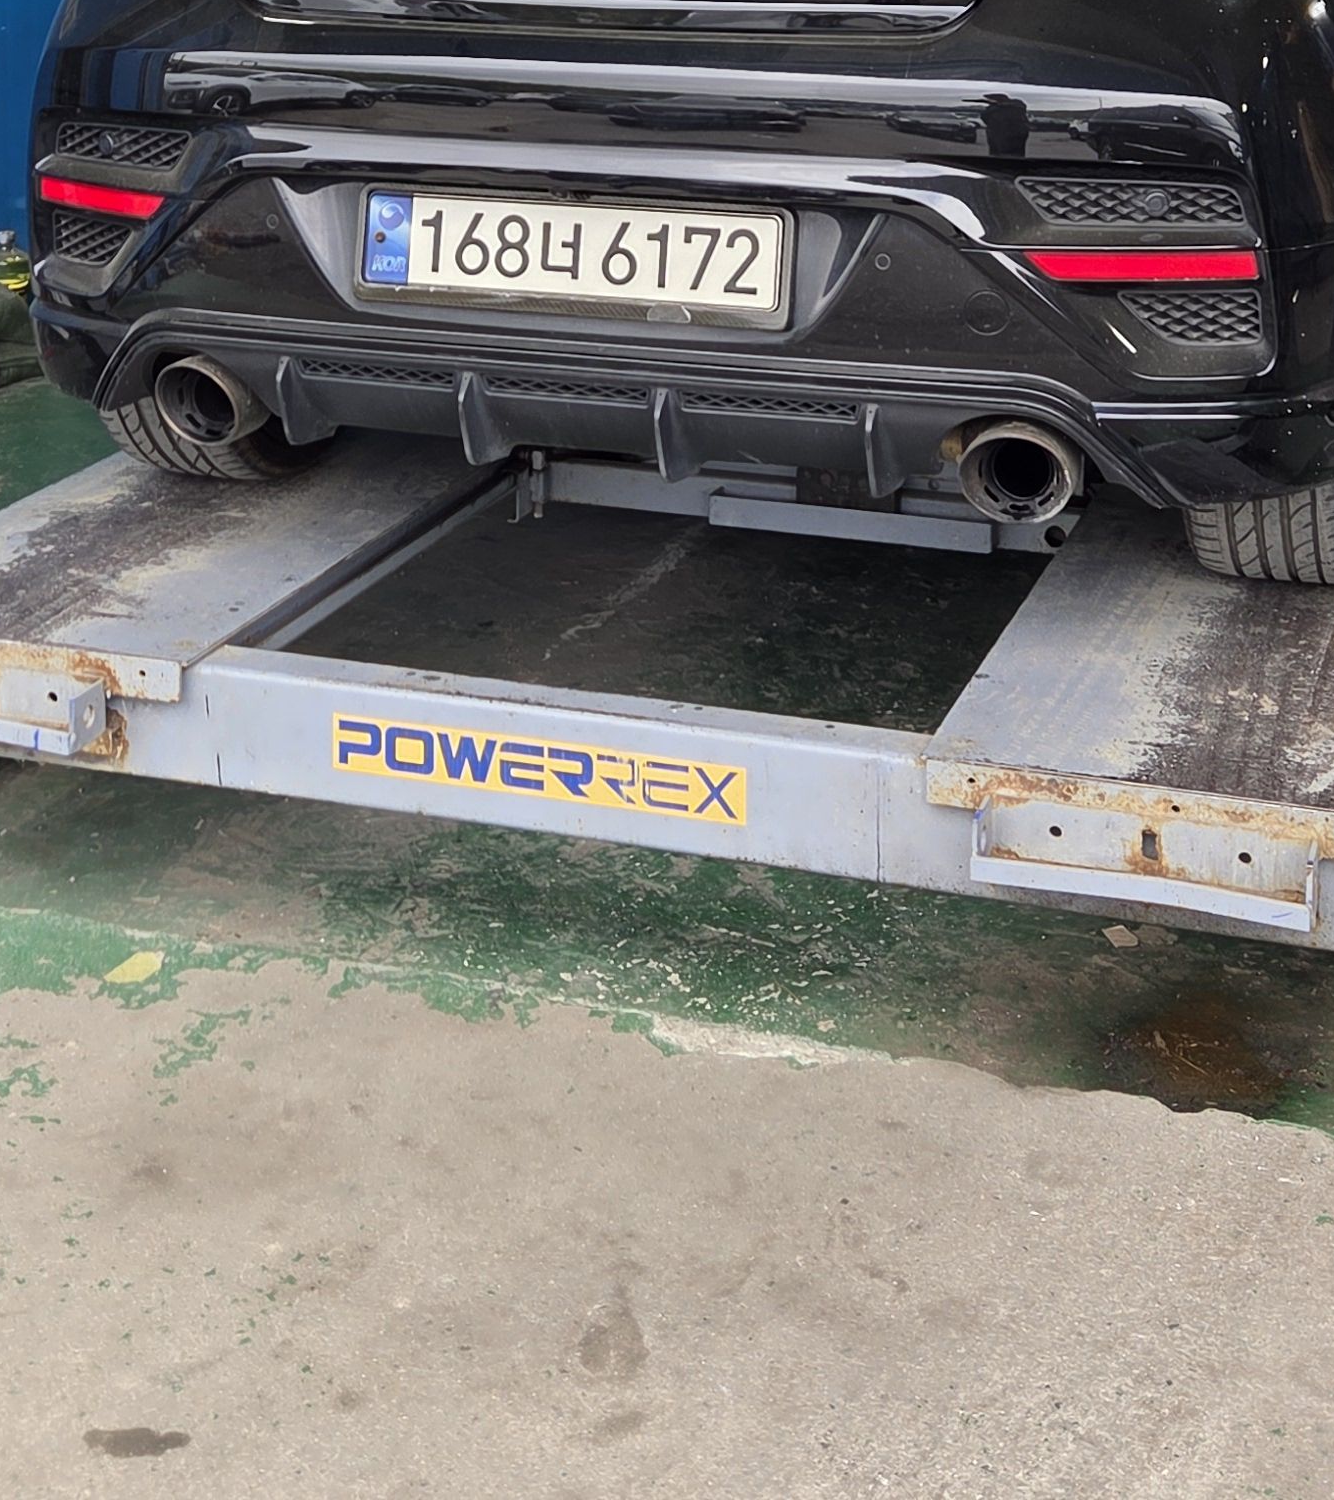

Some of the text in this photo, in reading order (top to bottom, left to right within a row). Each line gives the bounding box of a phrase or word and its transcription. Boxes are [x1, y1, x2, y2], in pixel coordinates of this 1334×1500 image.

[371, 254, 407, 273] KOR
[421, 209, 761, 296] 168너 6172
[338, 718, 738, 820] POWERREX
